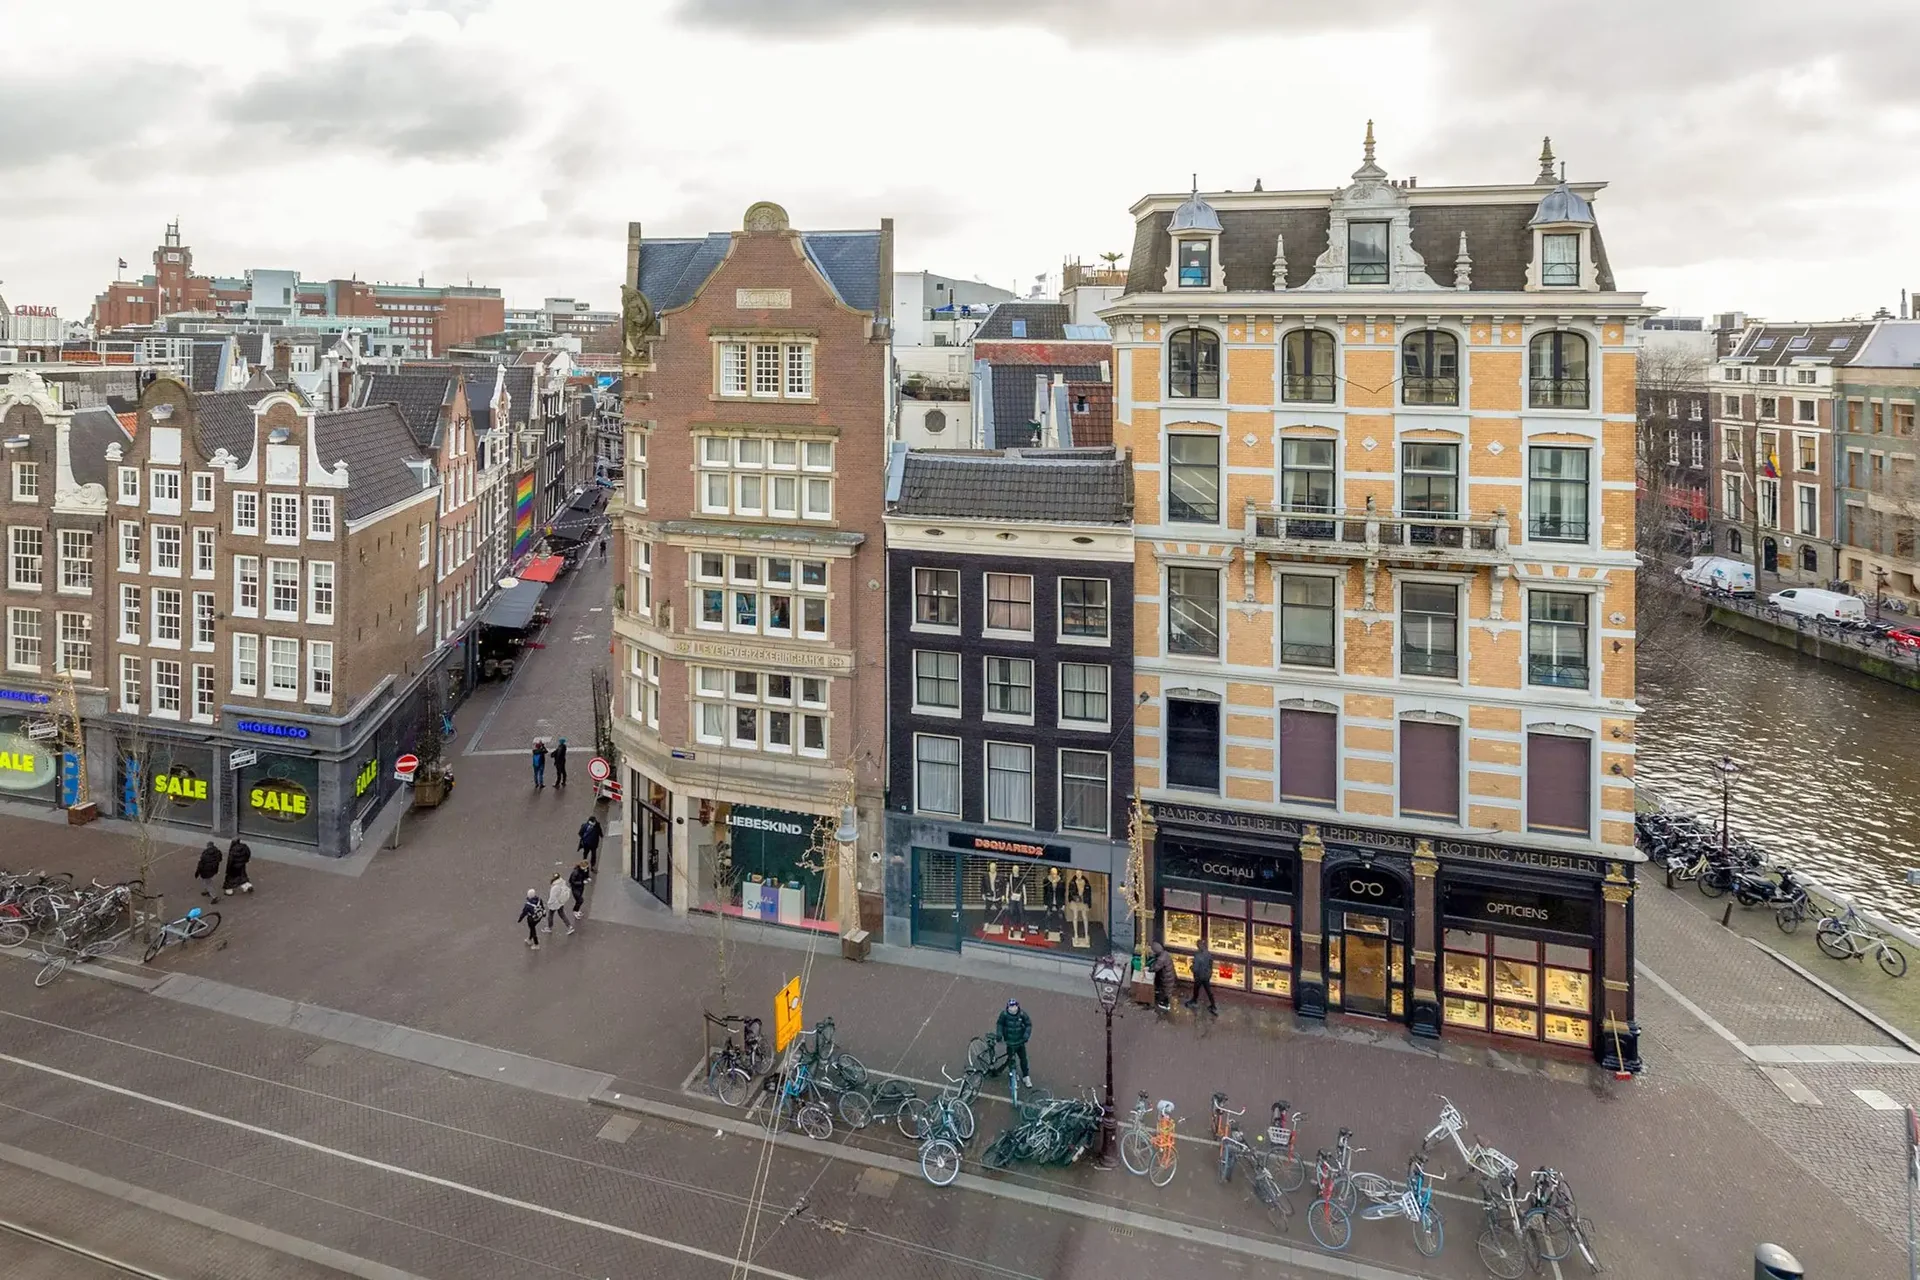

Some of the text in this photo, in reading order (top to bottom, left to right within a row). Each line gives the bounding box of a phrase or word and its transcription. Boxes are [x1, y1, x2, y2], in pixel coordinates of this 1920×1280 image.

[238, 720, 309, 739] SHOEBALOO
[155, 774, 207, 799] SALE
[251, 789, 306, 814] SALE
[726, 814, 802, 835] LIEBESKIND
[1158, 806, 1298, 834] BAMBOES MEUBELEN
[974, 838, 1043, 855] DSQUARED2
[1366, 832, 1411, 849] RIDDER
[1440, 842, 1597, 873] ROTTING MEUBELEN
[1486, 902, 1548, 920] OPTICIENS
